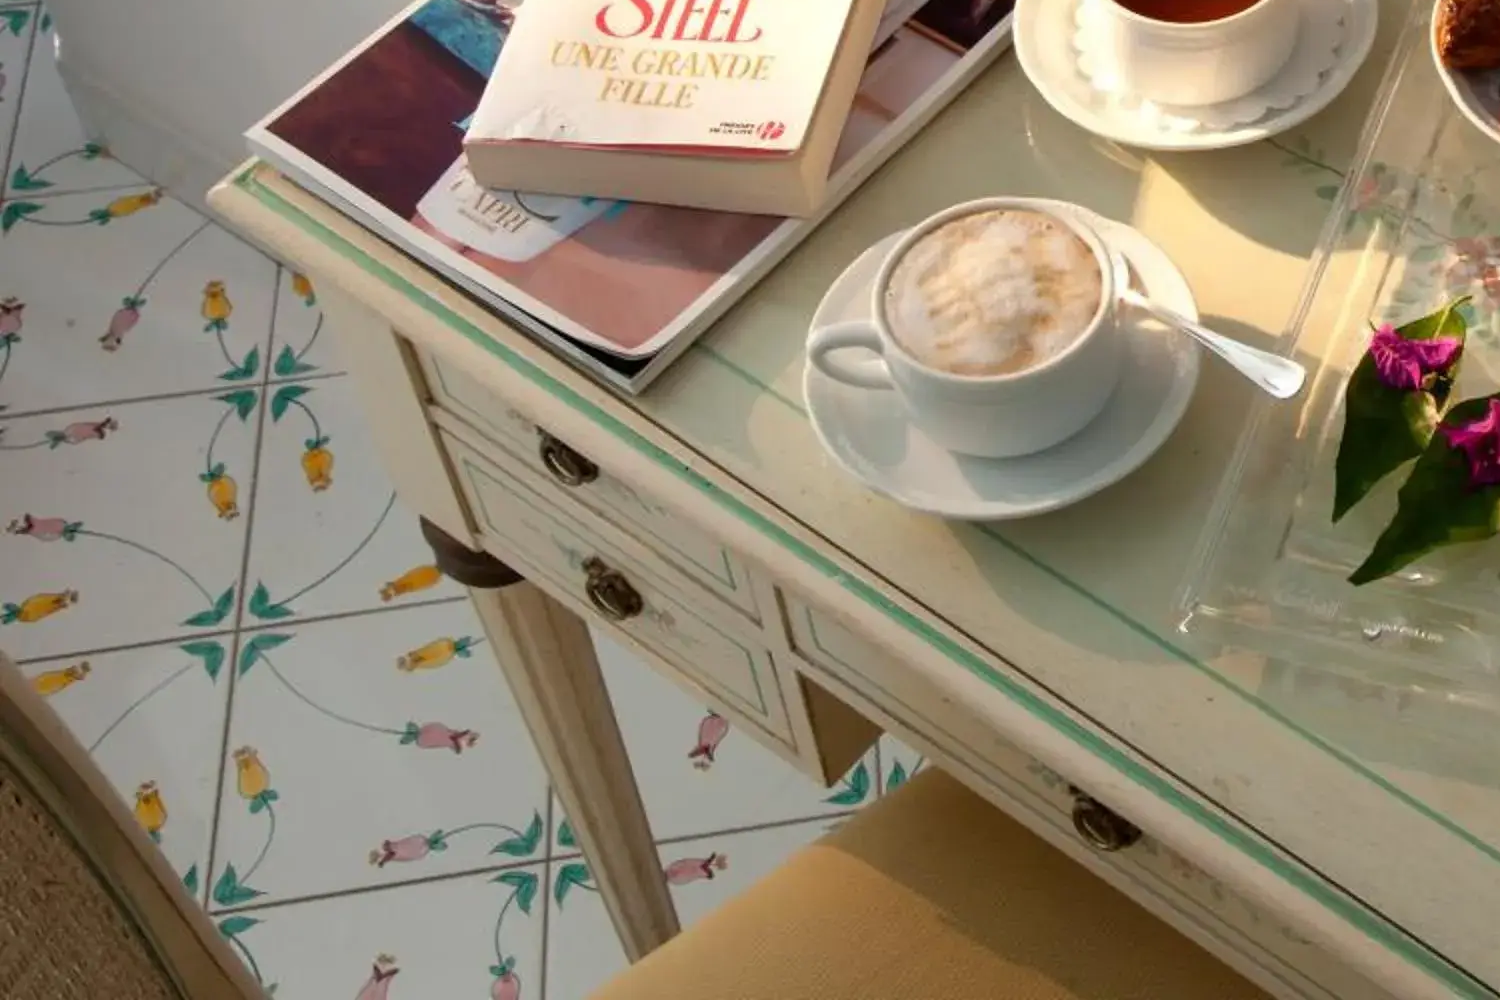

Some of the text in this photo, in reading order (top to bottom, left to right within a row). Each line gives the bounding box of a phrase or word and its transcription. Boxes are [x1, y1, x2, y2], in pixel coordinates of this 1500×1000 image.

[549, 39, 776, 82] UNE GRANDE
[596, 76, 699, 110] FILLE
